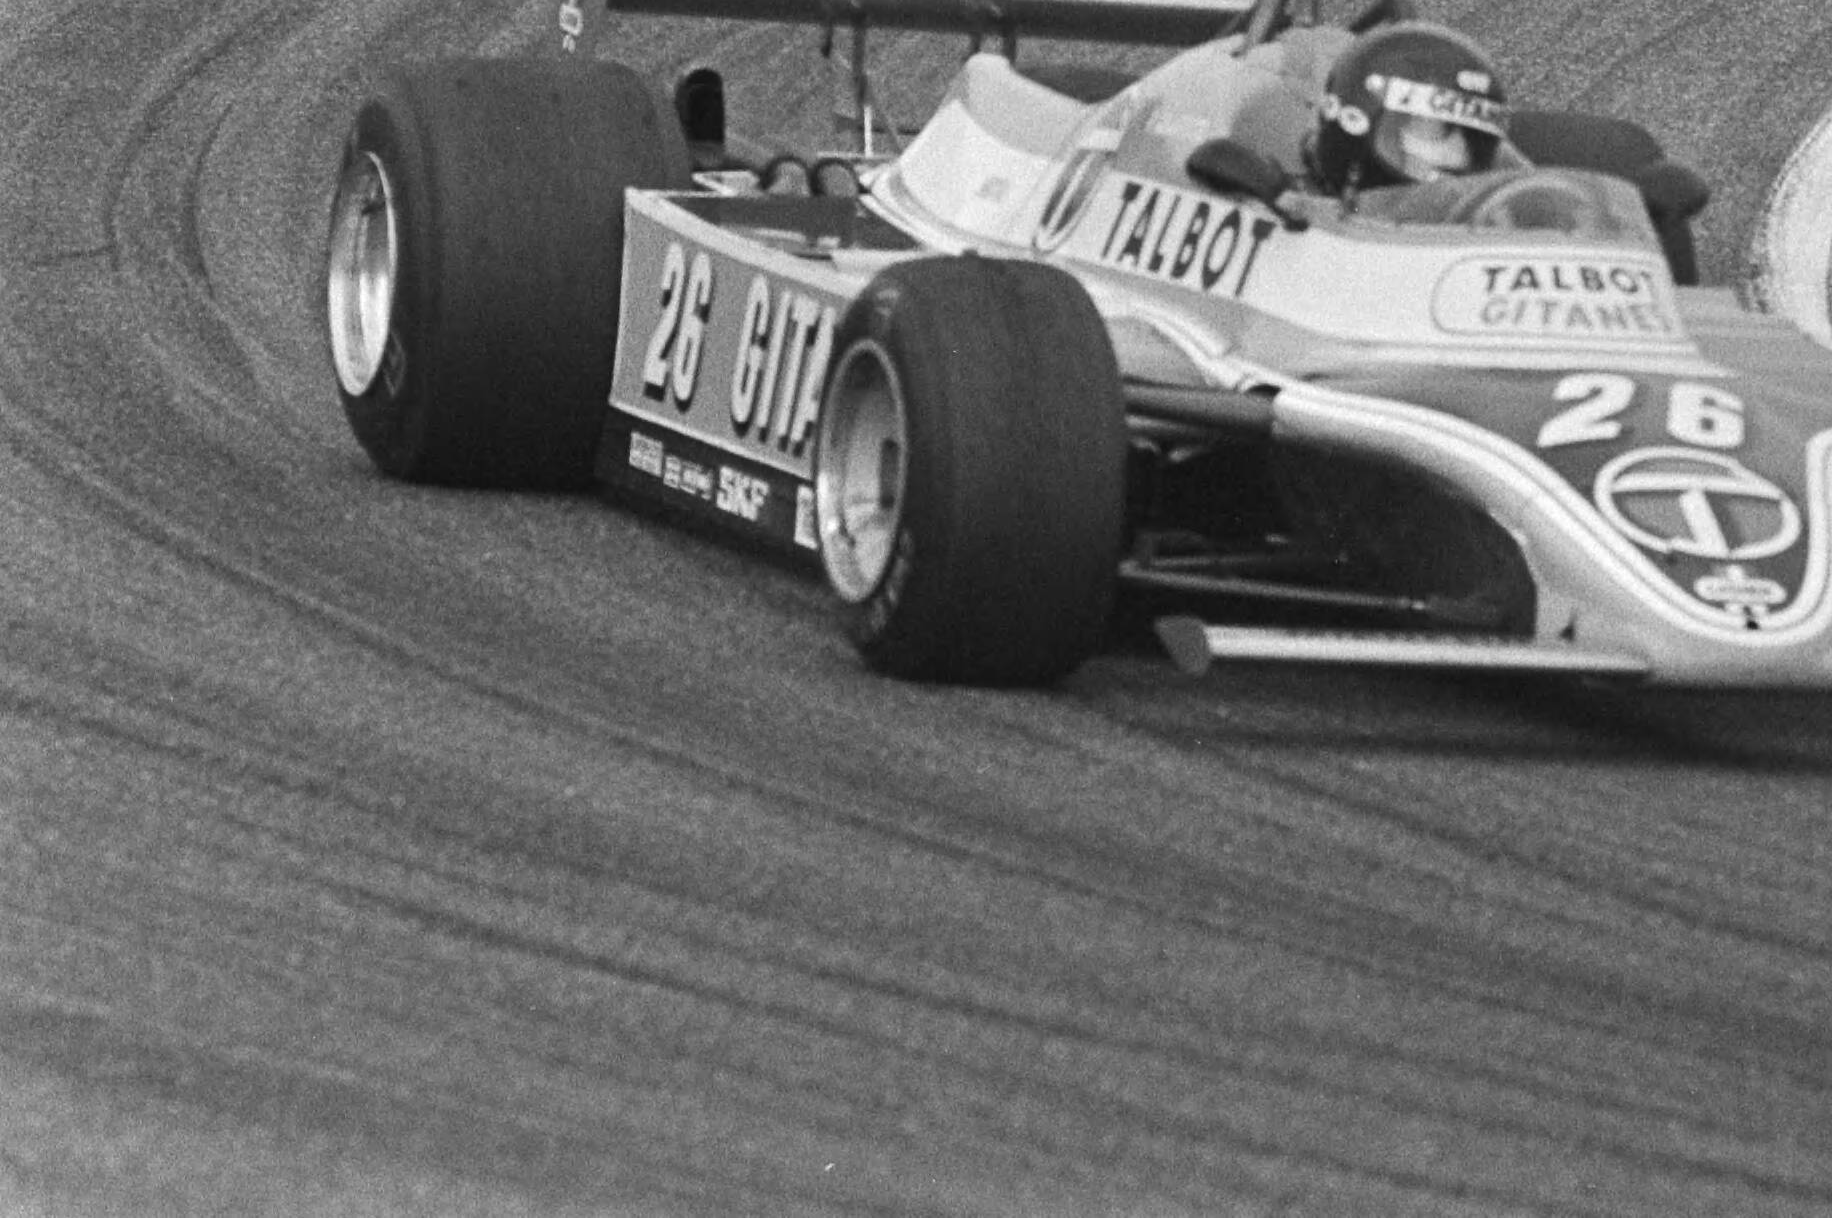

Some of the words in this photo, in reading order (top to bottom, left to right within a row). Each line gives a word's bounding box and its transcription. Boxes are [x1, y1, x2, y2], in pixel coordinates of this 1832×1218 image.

[1101, 182, 1277, 297] TALBOT
[643, 242, 713, 408] 26
[1537, 372, 1745, 449] 26
